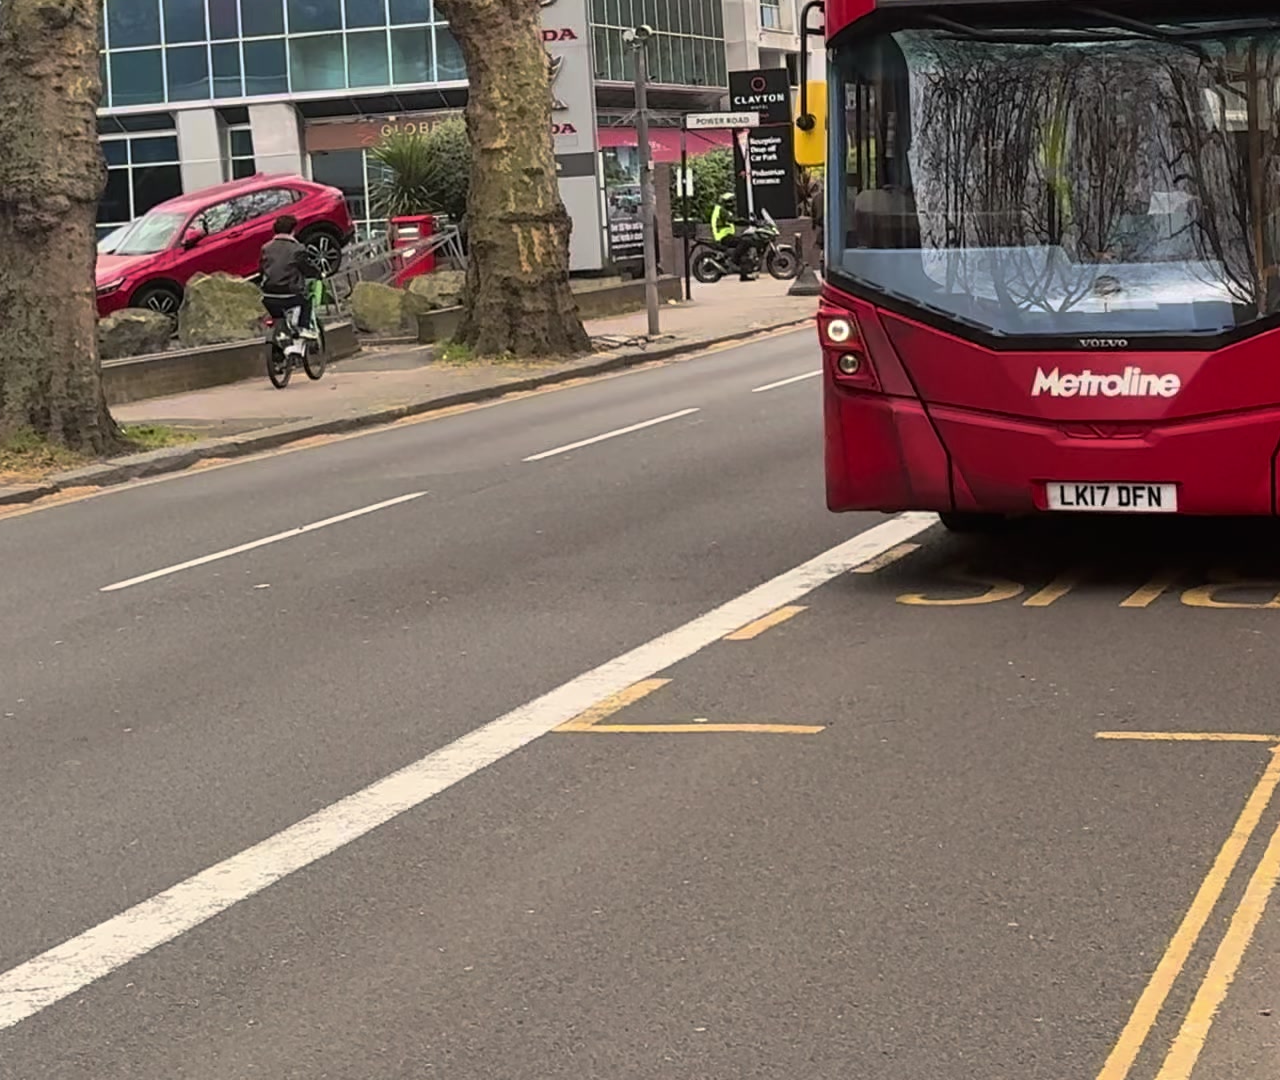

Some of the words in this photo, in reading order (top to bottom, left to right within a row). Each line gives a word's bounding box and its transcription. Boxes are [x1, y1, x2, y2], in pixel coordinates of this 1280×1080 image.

[734, 93, 785, 105] CLAYTON
[696, 117, 724, 125] POWER
[726, 116, 750, 124] ROAD
[1079, 338, 1129, 348] VOLVO
[1030, 366, 1181, 398] Metroline
[1060, 485, 1110, 507] LK17
[1118, 485, 1162, 508] DFN
